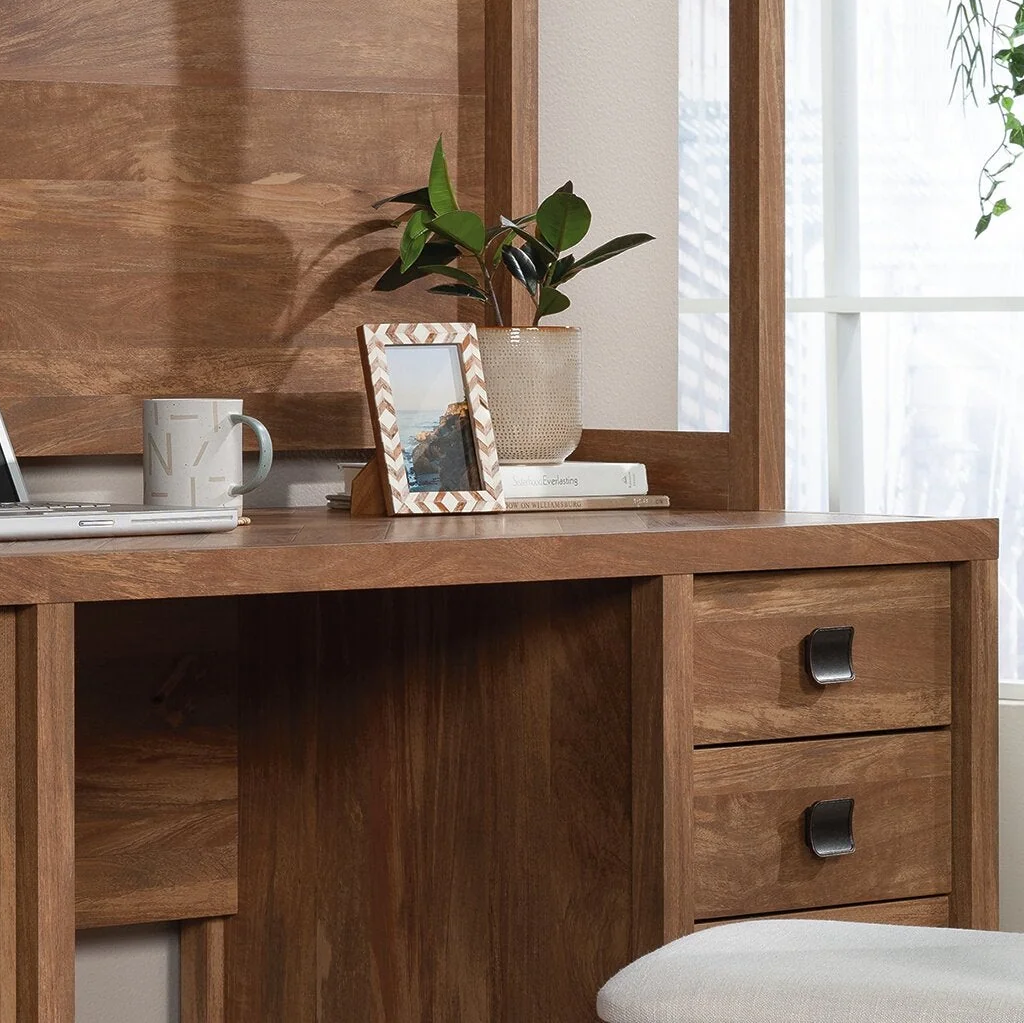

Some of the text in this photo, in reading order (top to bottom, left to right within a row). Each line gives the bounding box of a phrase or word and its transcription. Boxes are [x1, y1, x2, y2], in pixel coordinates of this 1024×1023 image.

[542, 475, 579, 487] Everlasting
[521, 501, 530, 509] ON
[531, 500, 582, 509] WILLIAMSBURG
